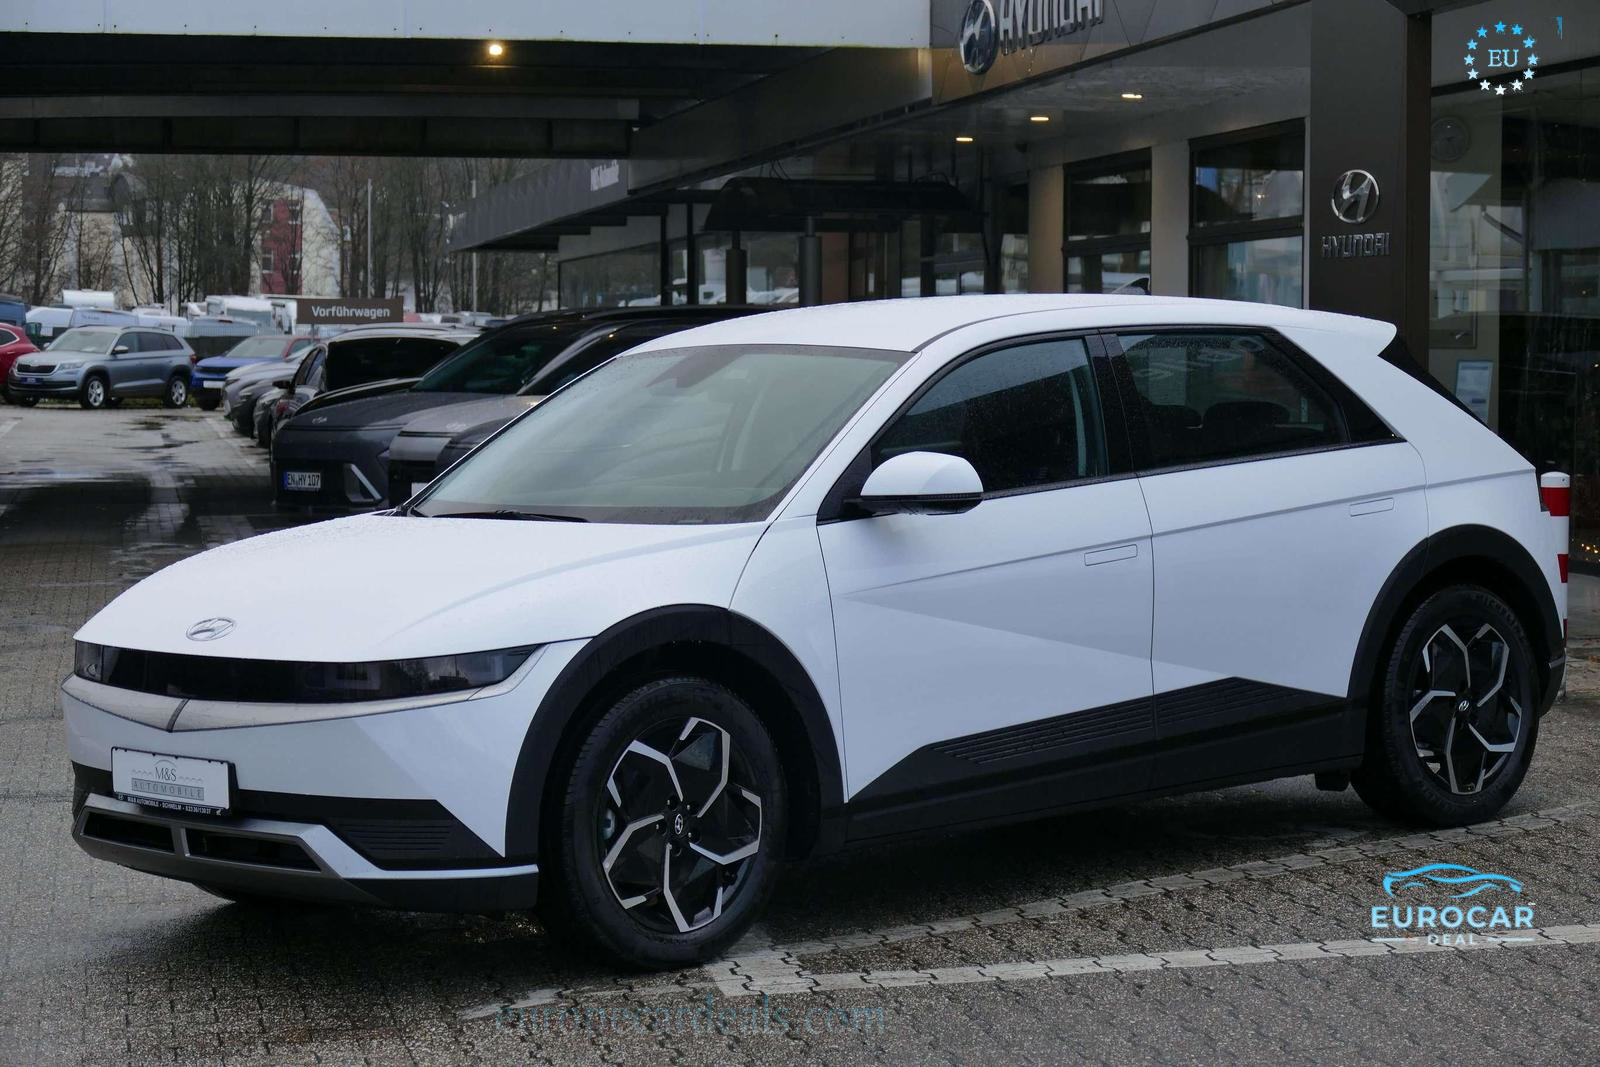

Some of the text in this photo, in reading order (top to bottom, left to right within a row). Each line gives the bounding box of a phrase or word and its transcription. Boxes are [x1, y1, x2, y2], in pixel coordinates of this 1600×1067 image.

[1321, 232, 1391, 257] HYUNDAI
[311, 305, 391, 320] Vorführwagen
[154, 766, 177, 783] M&S
